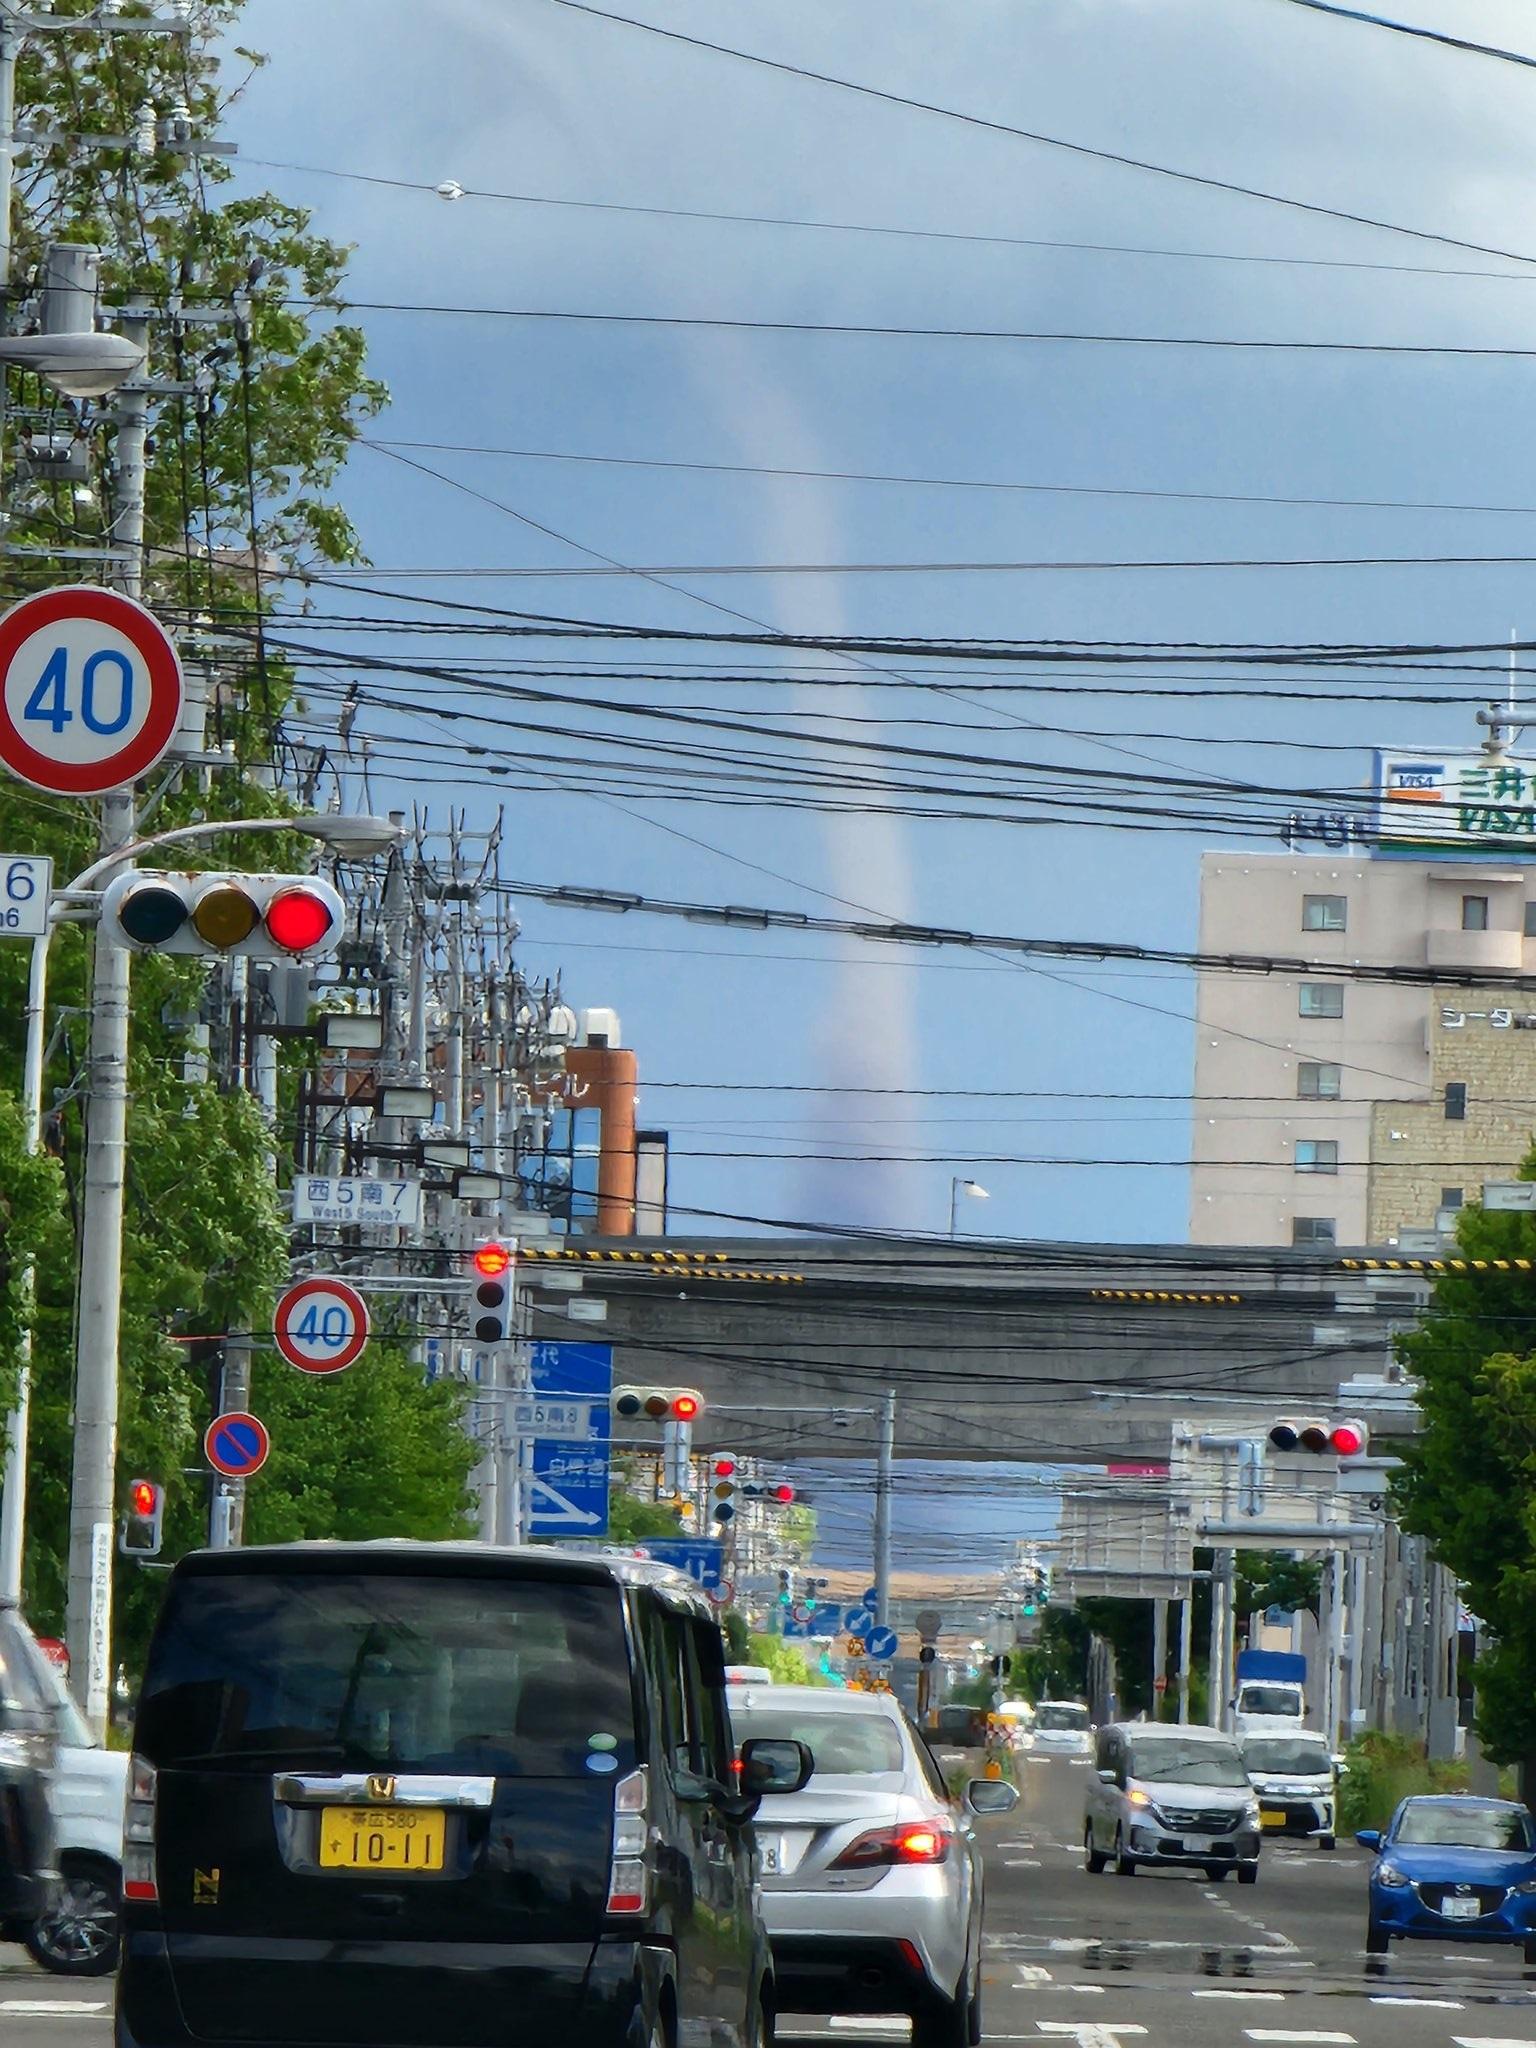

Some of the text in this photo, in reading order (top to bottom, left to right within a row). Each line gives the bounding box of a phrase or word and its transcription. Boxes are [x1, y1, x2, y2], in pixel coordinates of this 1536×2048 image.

[24, 647, 134, 735] 40
[6, 862, 35, 901] 6
[297, 1304, 347, 1347] 40
[352, 1831, 431, 1864] 10-11
